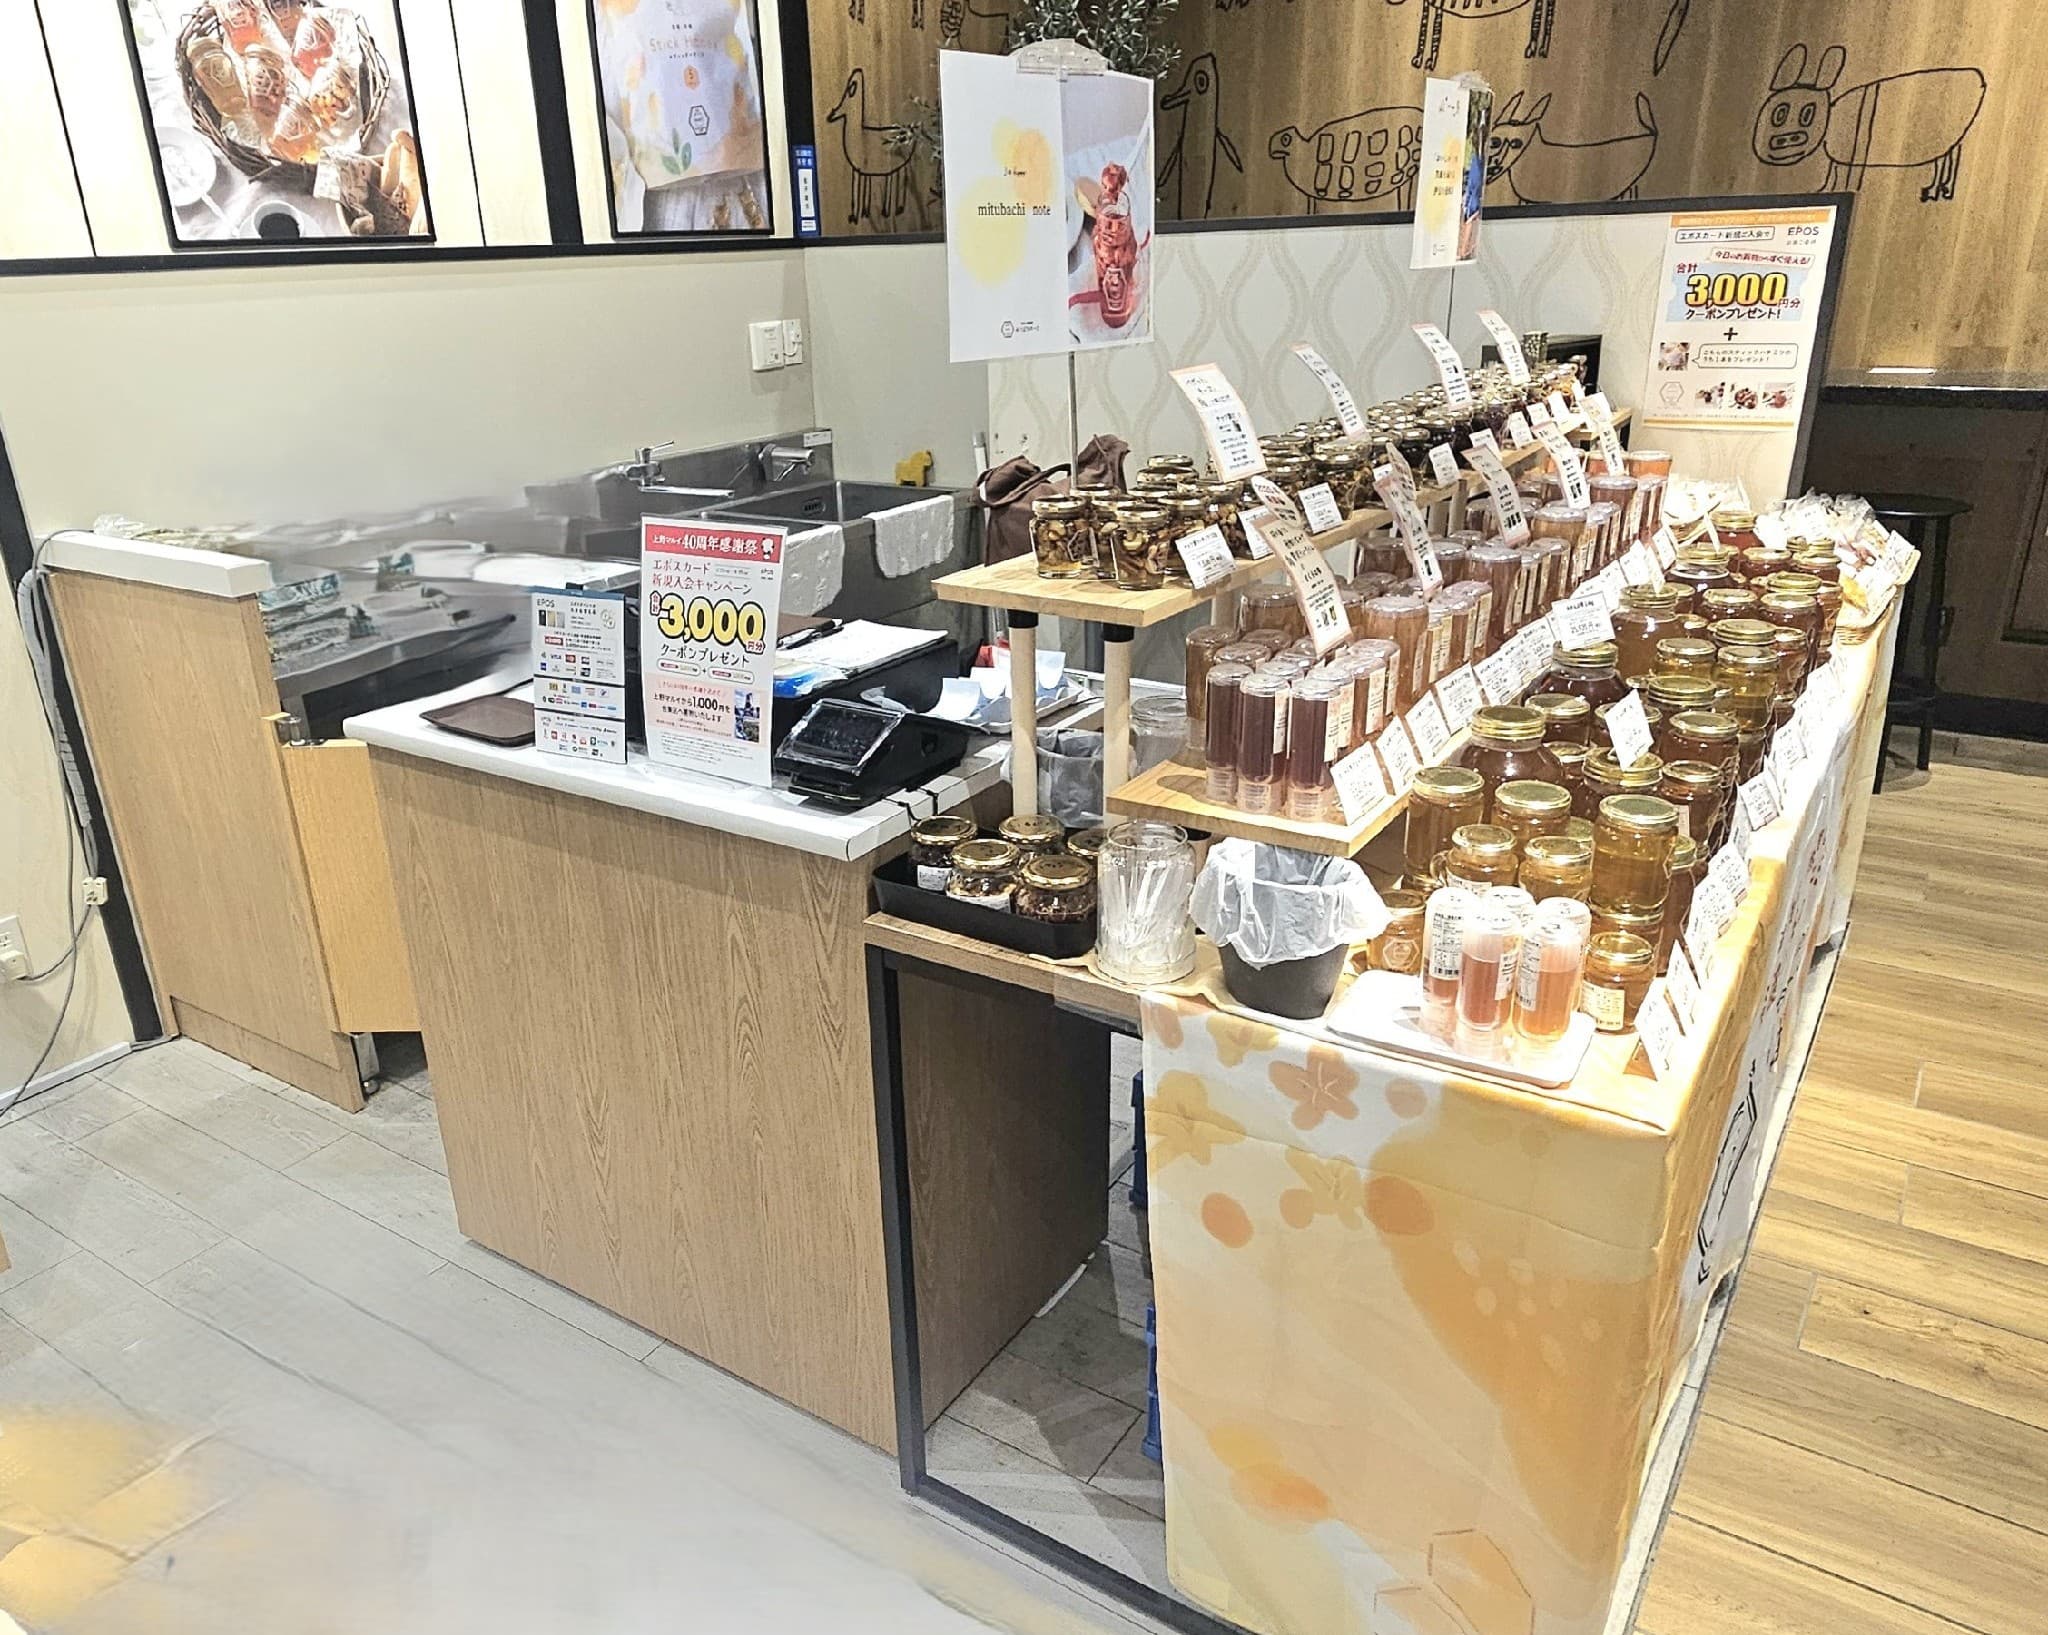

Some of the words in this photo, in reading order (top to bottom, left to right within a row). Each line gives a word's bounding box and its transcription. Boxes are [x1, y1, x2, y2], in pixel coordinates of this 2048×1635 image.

[978, 202, 1026, 216] mitubachi
[1032, 204, 1051, 216] note
[1787, 226, 1820, 236] EPOS
[1676, 263, 1698, 274] 合計
[1685, 272, 1788, 310] 3,000
[1778, 298, 1801, 309] 円分
[536, 598, 555, 608] EPOS
[658, 592, 766, 647] 3,000
[660, 643, 750, 668] クーポンプレゼント
